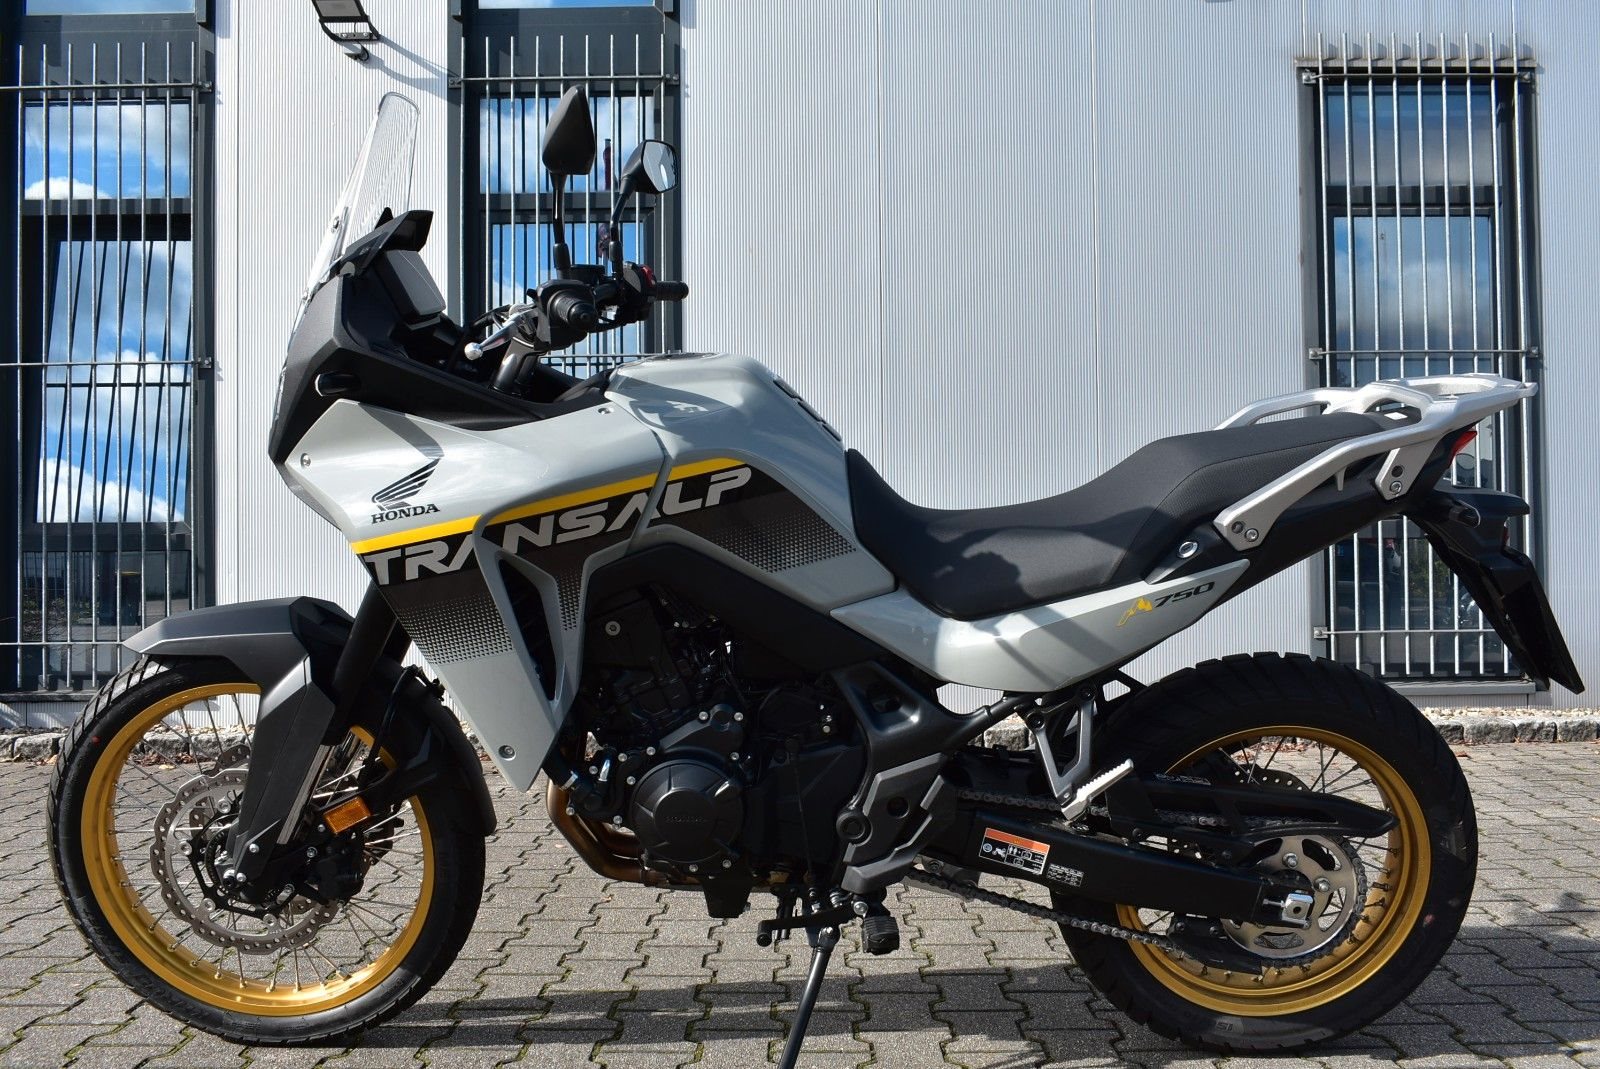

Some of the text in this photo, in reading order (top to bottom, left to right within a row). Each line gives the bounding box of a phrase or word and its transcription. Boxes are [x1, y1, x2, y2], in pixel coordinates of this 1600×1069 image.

[364, 467, 752, 585] TRANSALP
[371, 503, 440, 524] HONDA
[1154, 581, 1215, 608] 750
